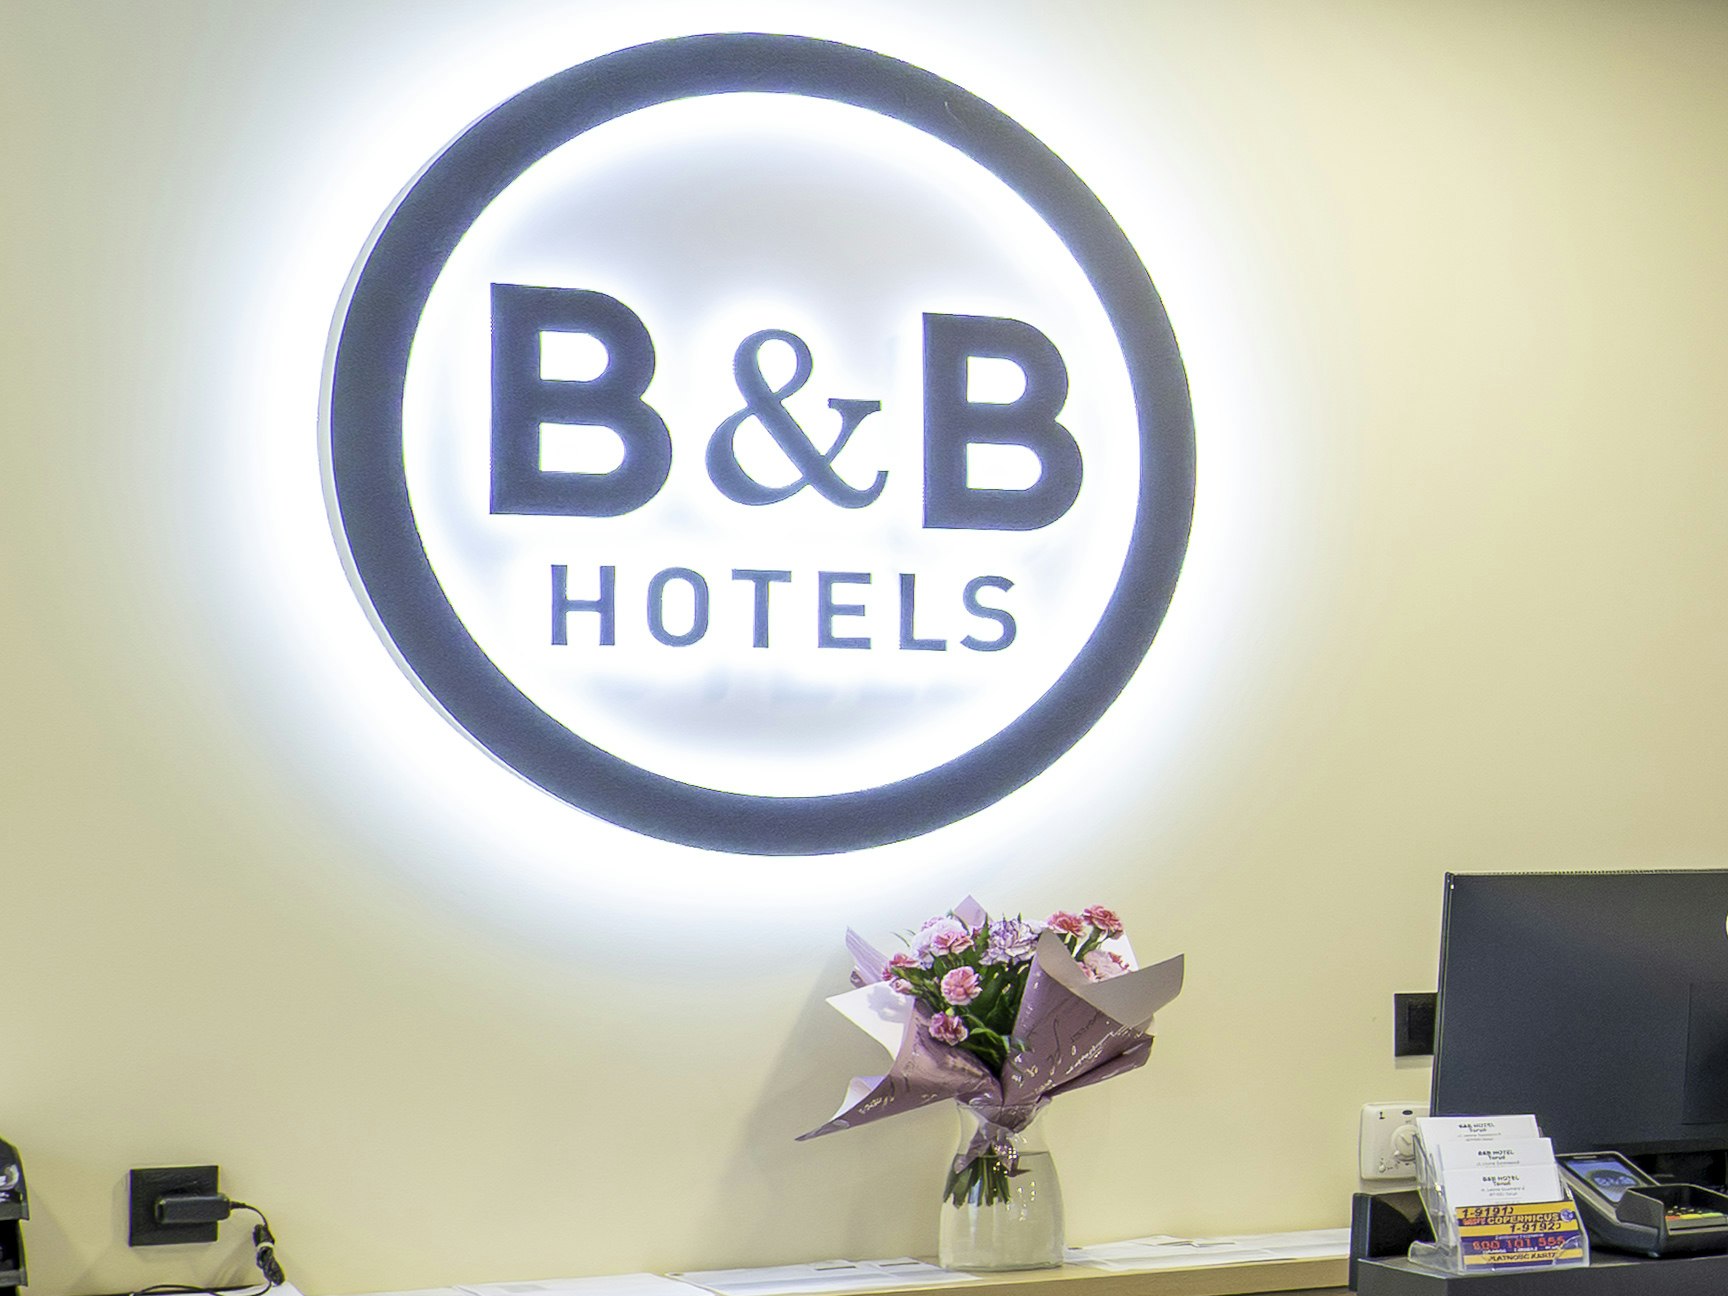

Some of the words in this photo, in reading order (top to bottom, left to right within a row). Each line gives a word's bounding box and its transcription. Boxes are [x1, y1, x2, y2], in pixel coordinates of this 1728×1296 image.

[490, 283, 1083, 532] B&B
[550, 564, 1018, 653] HOTELS
[1487, 1212, 1560, 1225] COPERNICUS
